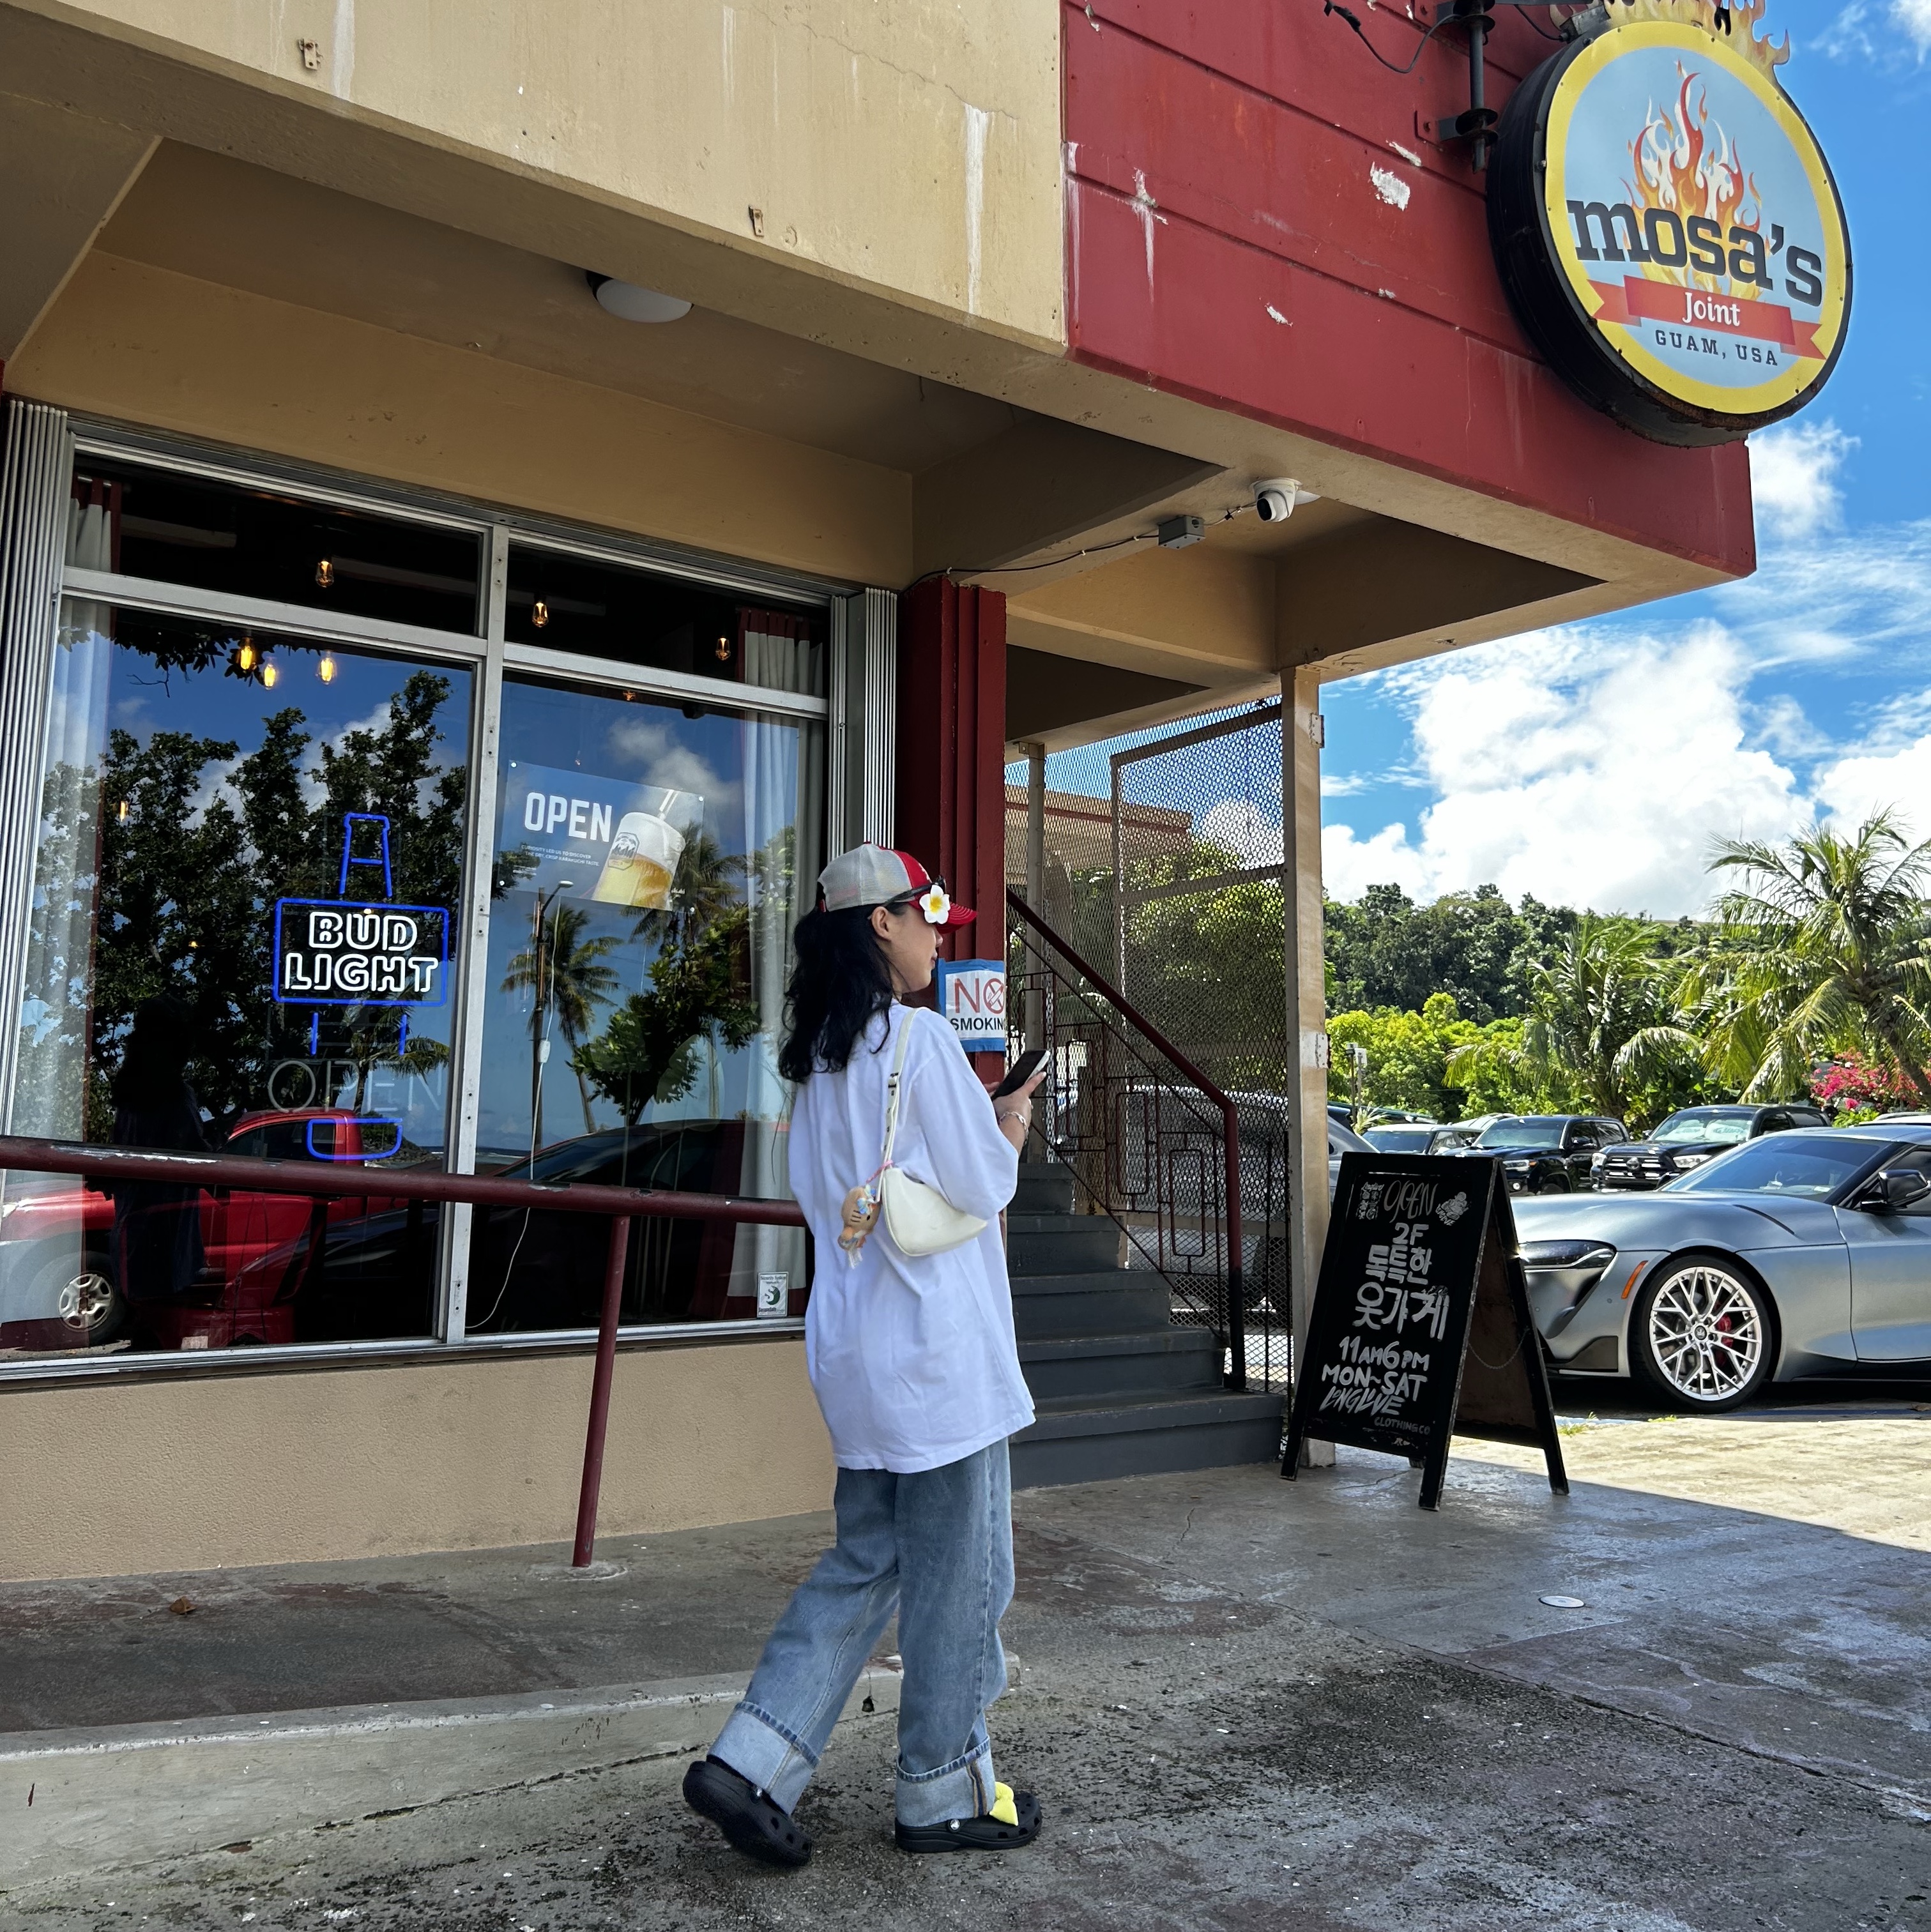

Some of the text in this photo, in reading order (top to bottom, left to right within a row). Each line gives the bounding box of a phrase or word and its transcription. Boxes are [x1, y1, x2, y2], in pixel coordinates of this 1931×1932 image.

[1566, 200, 1822, 307] mosa's
[1682, 292, 1741, 327] Joint
[1655, 330, 1778, 367] GUAM, USA
[524, 792, 613, 842] OPEN
[521, 844, 546, 853] CURIOSITY
[309, 911, 417, 951] BUD
[285, 953, 439, 992] LIGHT
[950, 1017, 1006, 1031] SMOKIN
[268, 1060, 443, 1113] OPEN
[1384, 1180, 1439, 1224] OPEN
[1393, 1222, 1429, 1245] 2F
[1365, 1244, 1432, 1285] 독특한
[1352, 1281, 1449, 1341] 옷가게
